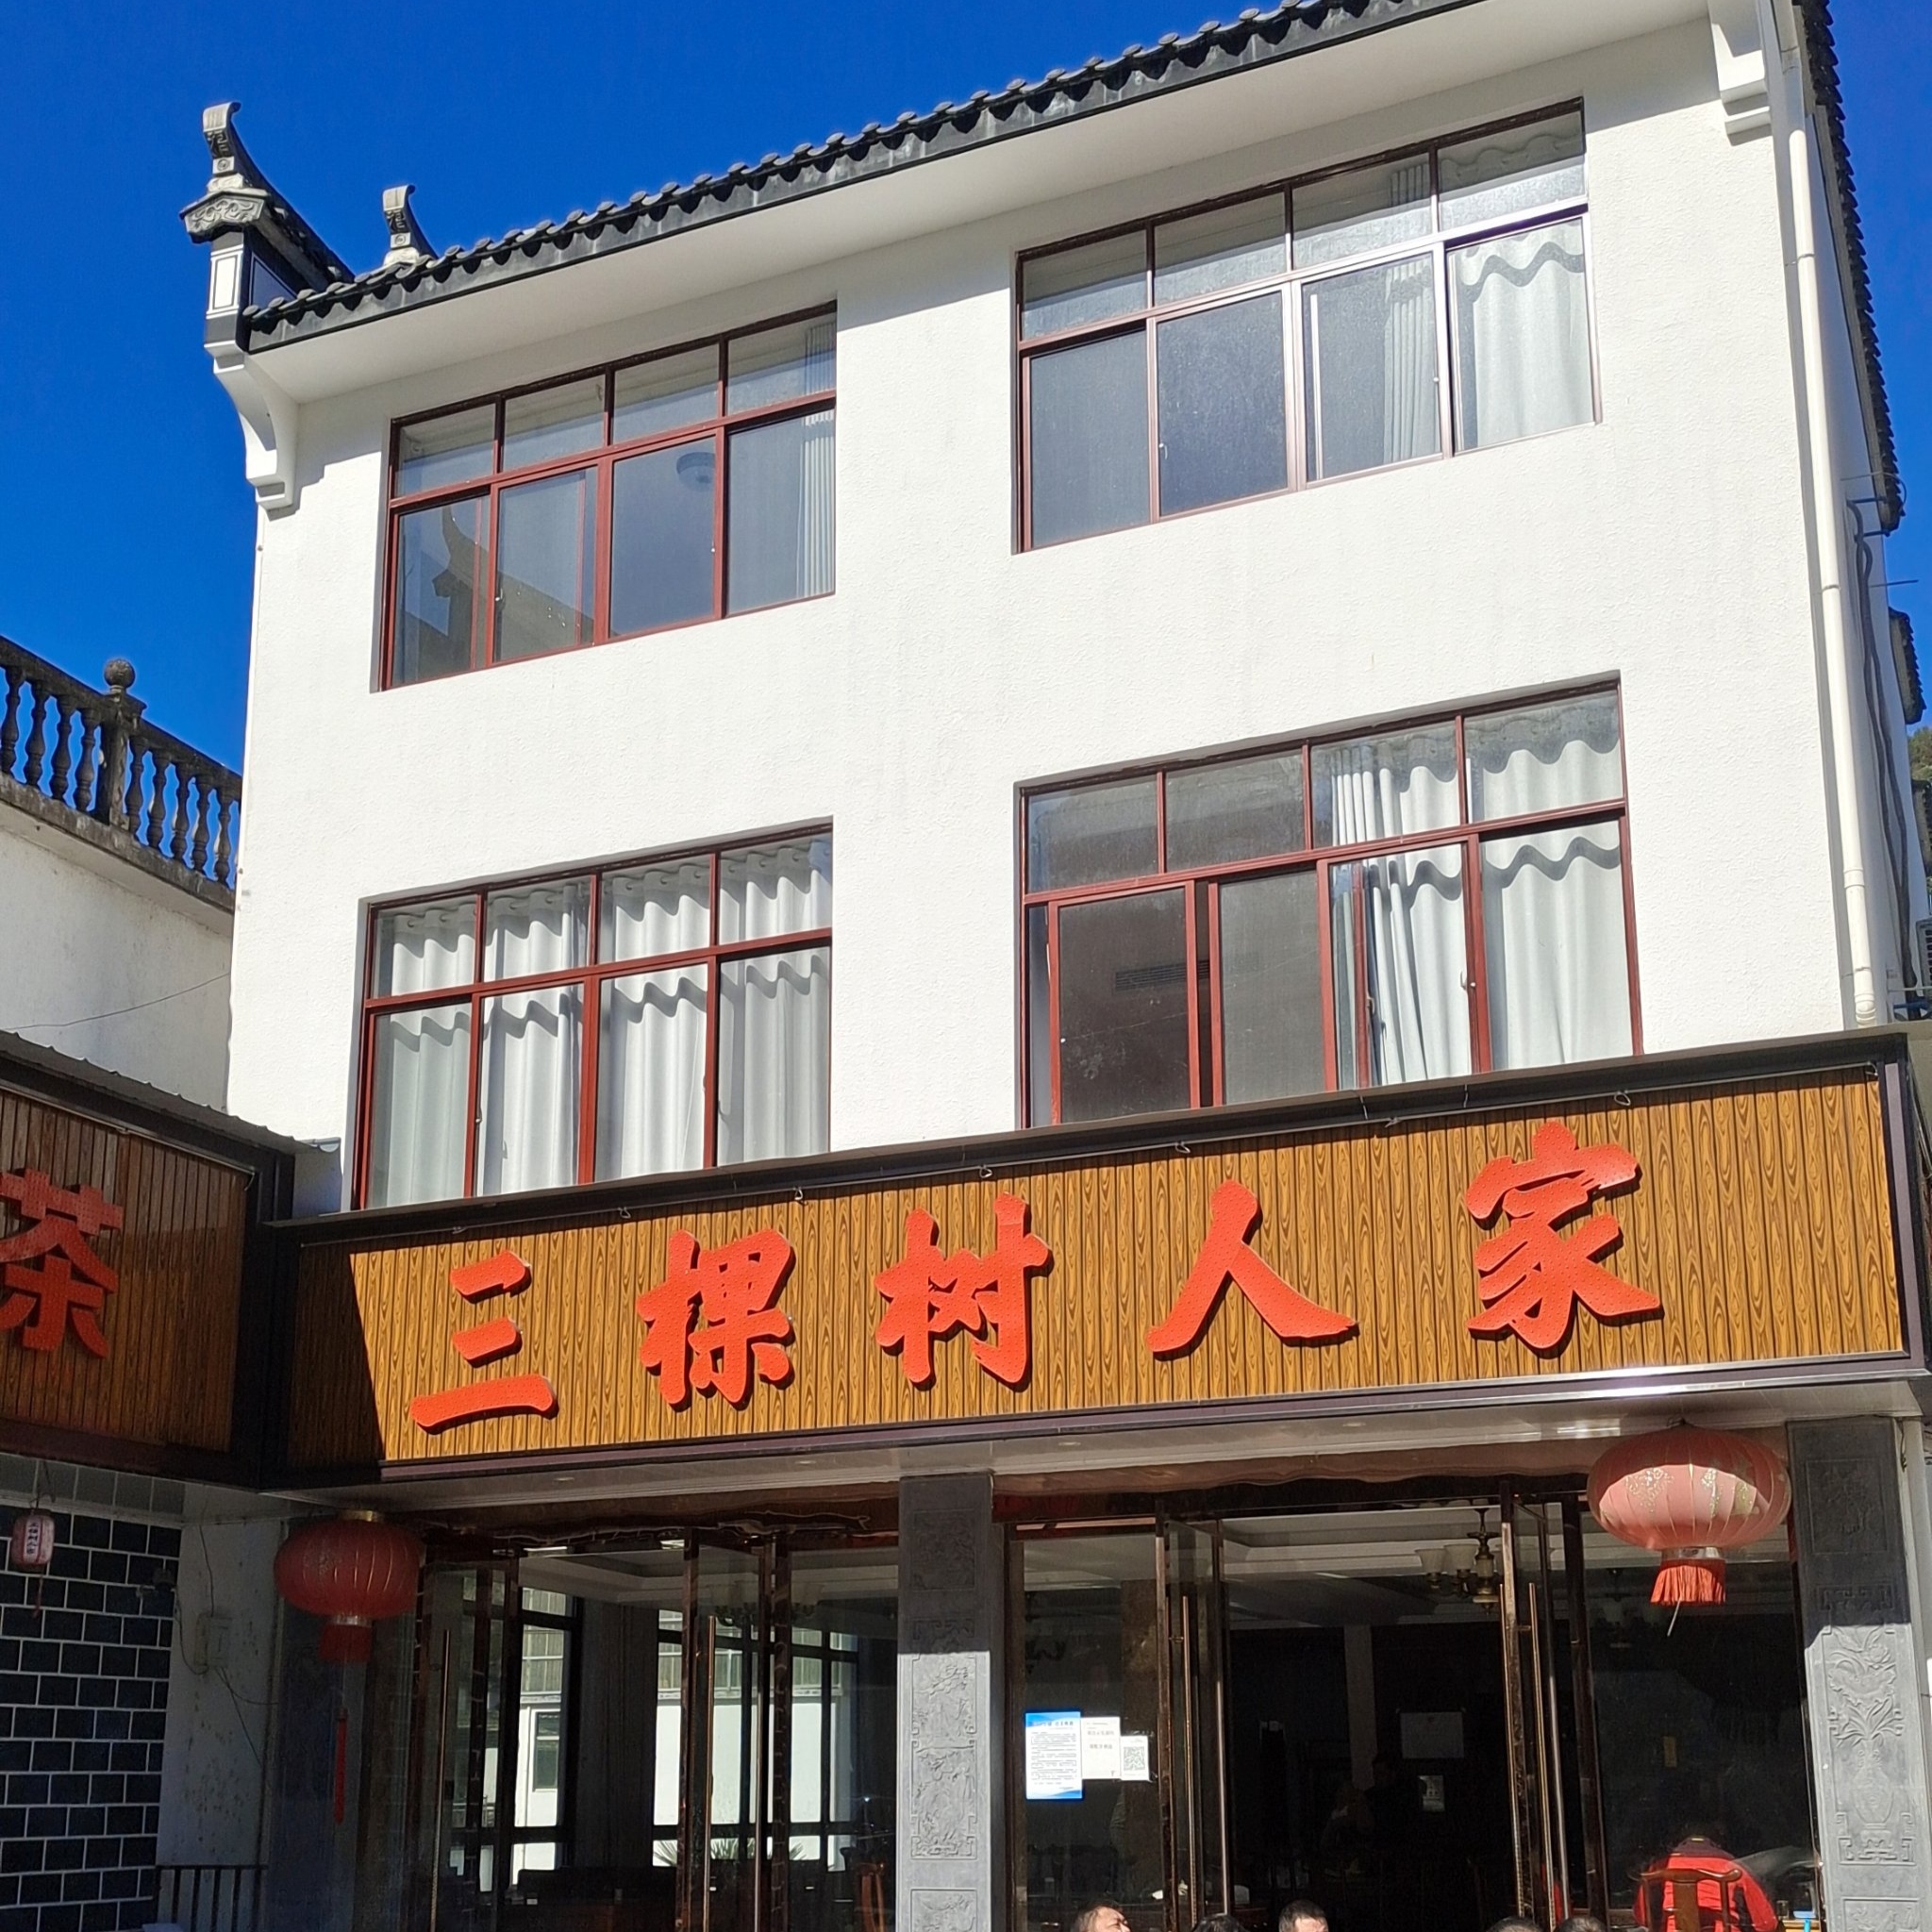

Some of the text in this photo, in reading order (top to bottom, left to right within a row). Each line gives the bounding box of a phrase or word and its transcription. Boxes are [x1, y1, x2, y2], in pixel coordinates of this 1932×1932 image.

[409, 1121, 1660, 1426] 三棵树人家
